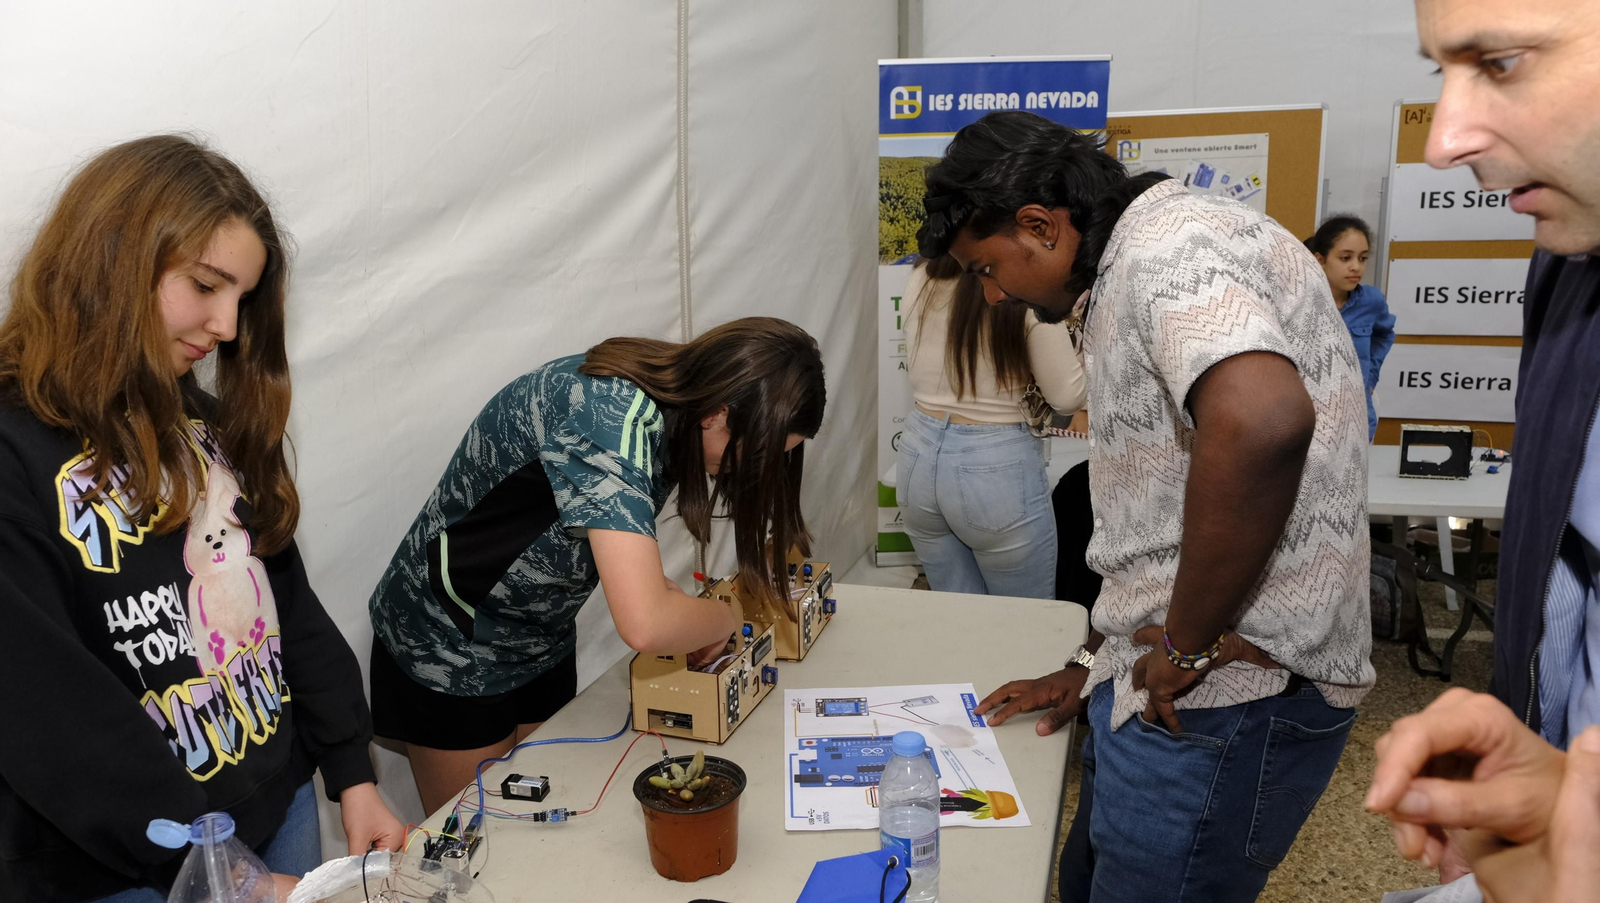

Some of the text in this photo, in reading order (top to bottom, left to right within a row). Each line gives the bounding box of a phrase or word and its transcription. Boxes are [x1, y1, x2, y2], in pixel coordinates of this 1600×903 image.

[929, 94, 953, 111] IES
[958, 92, 1020, 110] SIERRA
[1025, 91, 1099, 109] NEVADA
[1420, 190, 1509, 209] IES Sier
[1415, 286, 1525, 304] IES Sierra
[1399, 371, 1512, 391] IES Sierra
[103, 582, 186, 633] HAPPY
